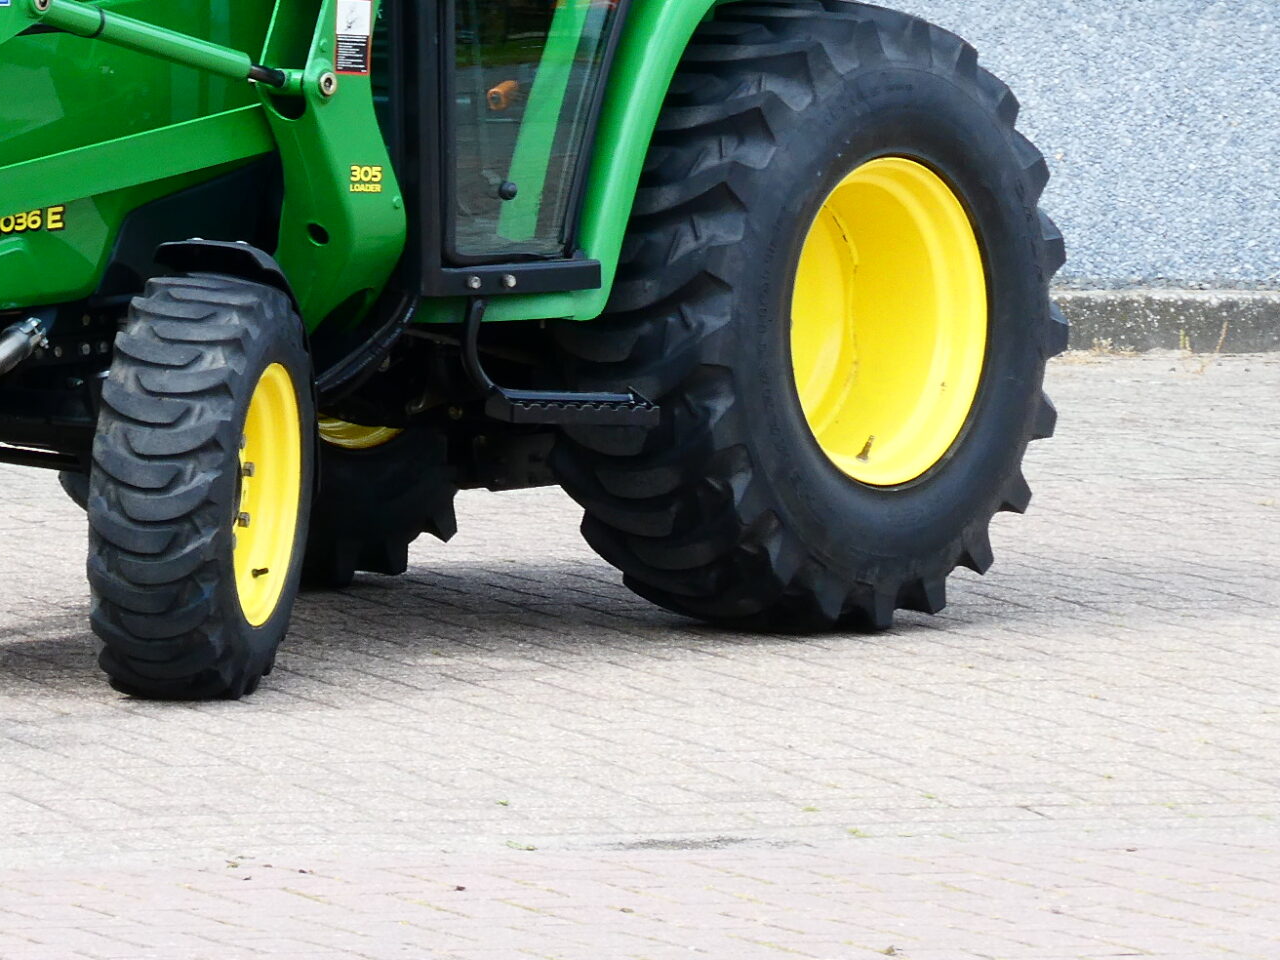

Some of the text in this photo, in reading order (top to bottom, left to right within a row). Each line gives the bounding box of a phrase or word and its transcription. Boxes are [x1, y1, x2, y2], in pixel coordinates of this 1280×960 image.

[350, 164, 383, 182] 305
[350, 183, 382, 192] LOADER
[46, 205, 65, 230] E
